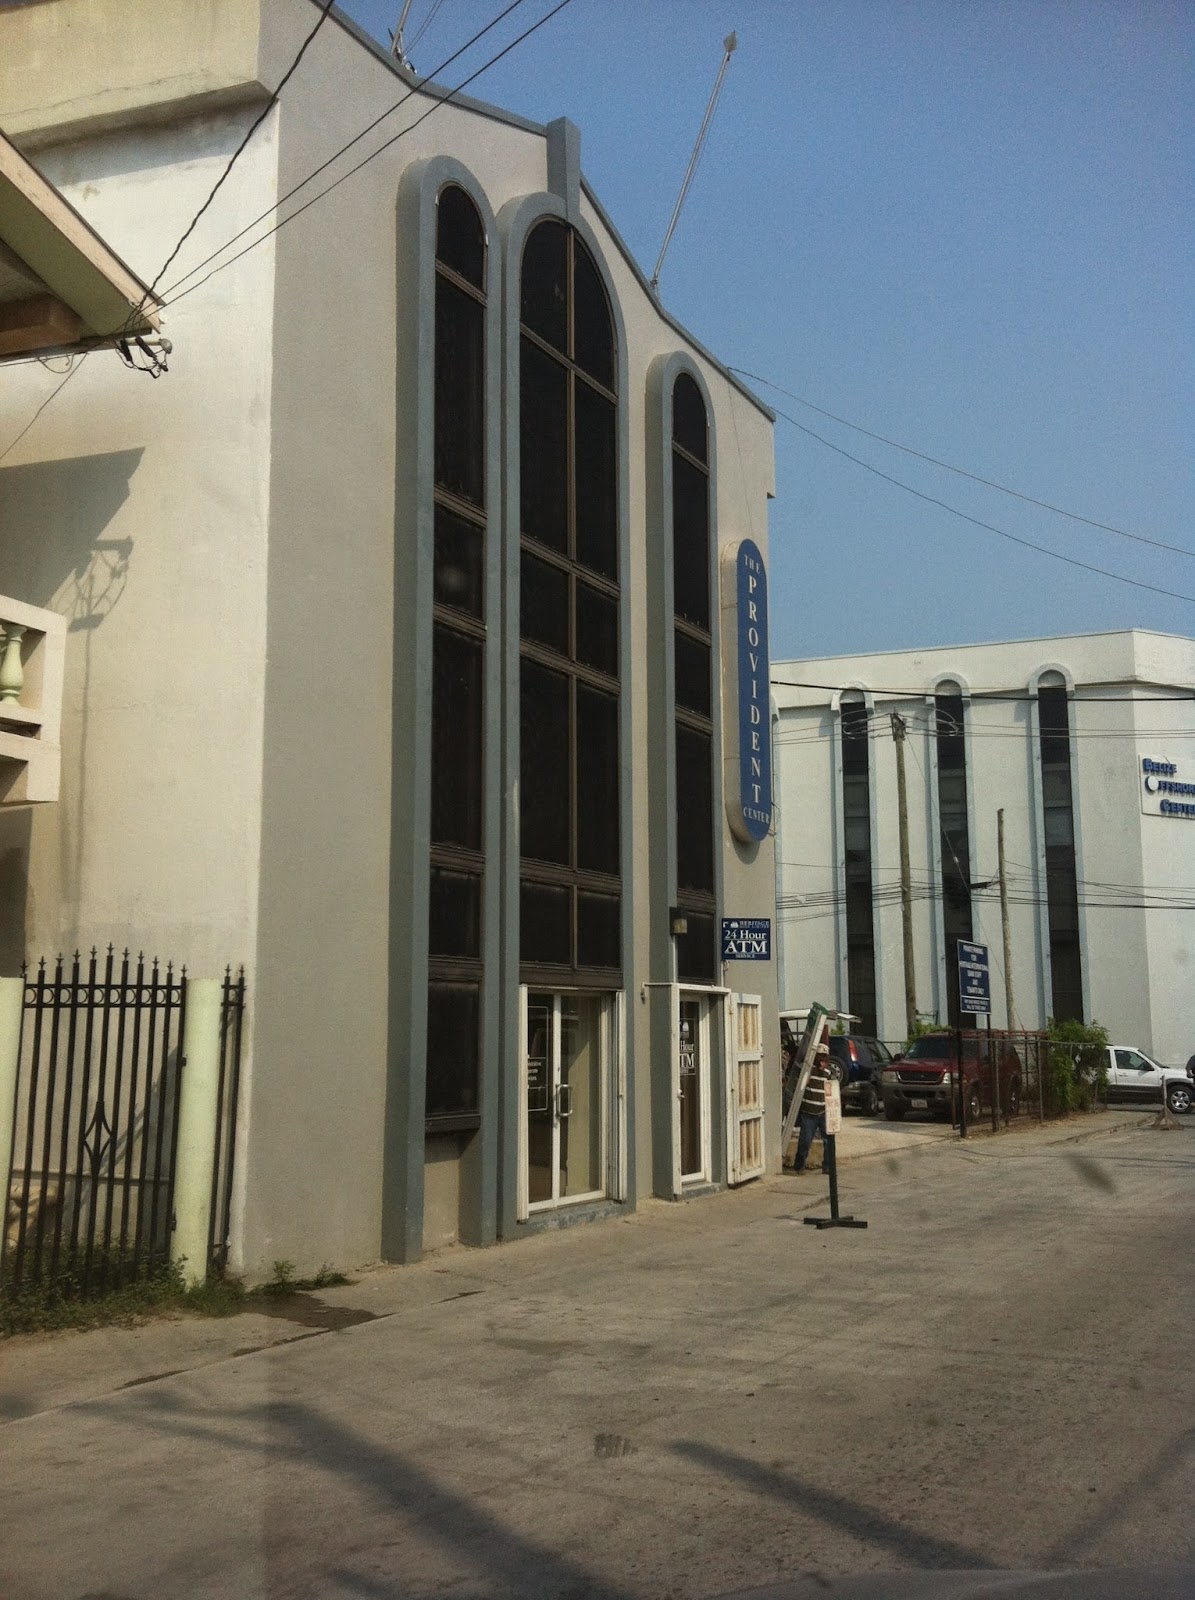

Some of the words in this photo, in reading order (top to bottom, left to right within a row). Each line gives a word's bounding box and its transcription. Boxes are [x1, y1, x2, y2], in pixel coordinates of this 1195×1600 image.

[744, 554, 761, 574] THE
[748, 575, 761, 804] PROVIDENT
[1142, 758, 1177, 775] BELIZE
[1145, 775, 1195, 795] OFFSHOR
[1160, 798, 1195, 814] CENTE
[743, 806, 769, 824] CENTER
[724, 929, 737, 939] 24
[740, 929, 767, 939] Hour
[724, 940, 767, 954] ATM
[680, 1040, 694, 1051] Hour
[680, 1053, 694, 1068] TM
